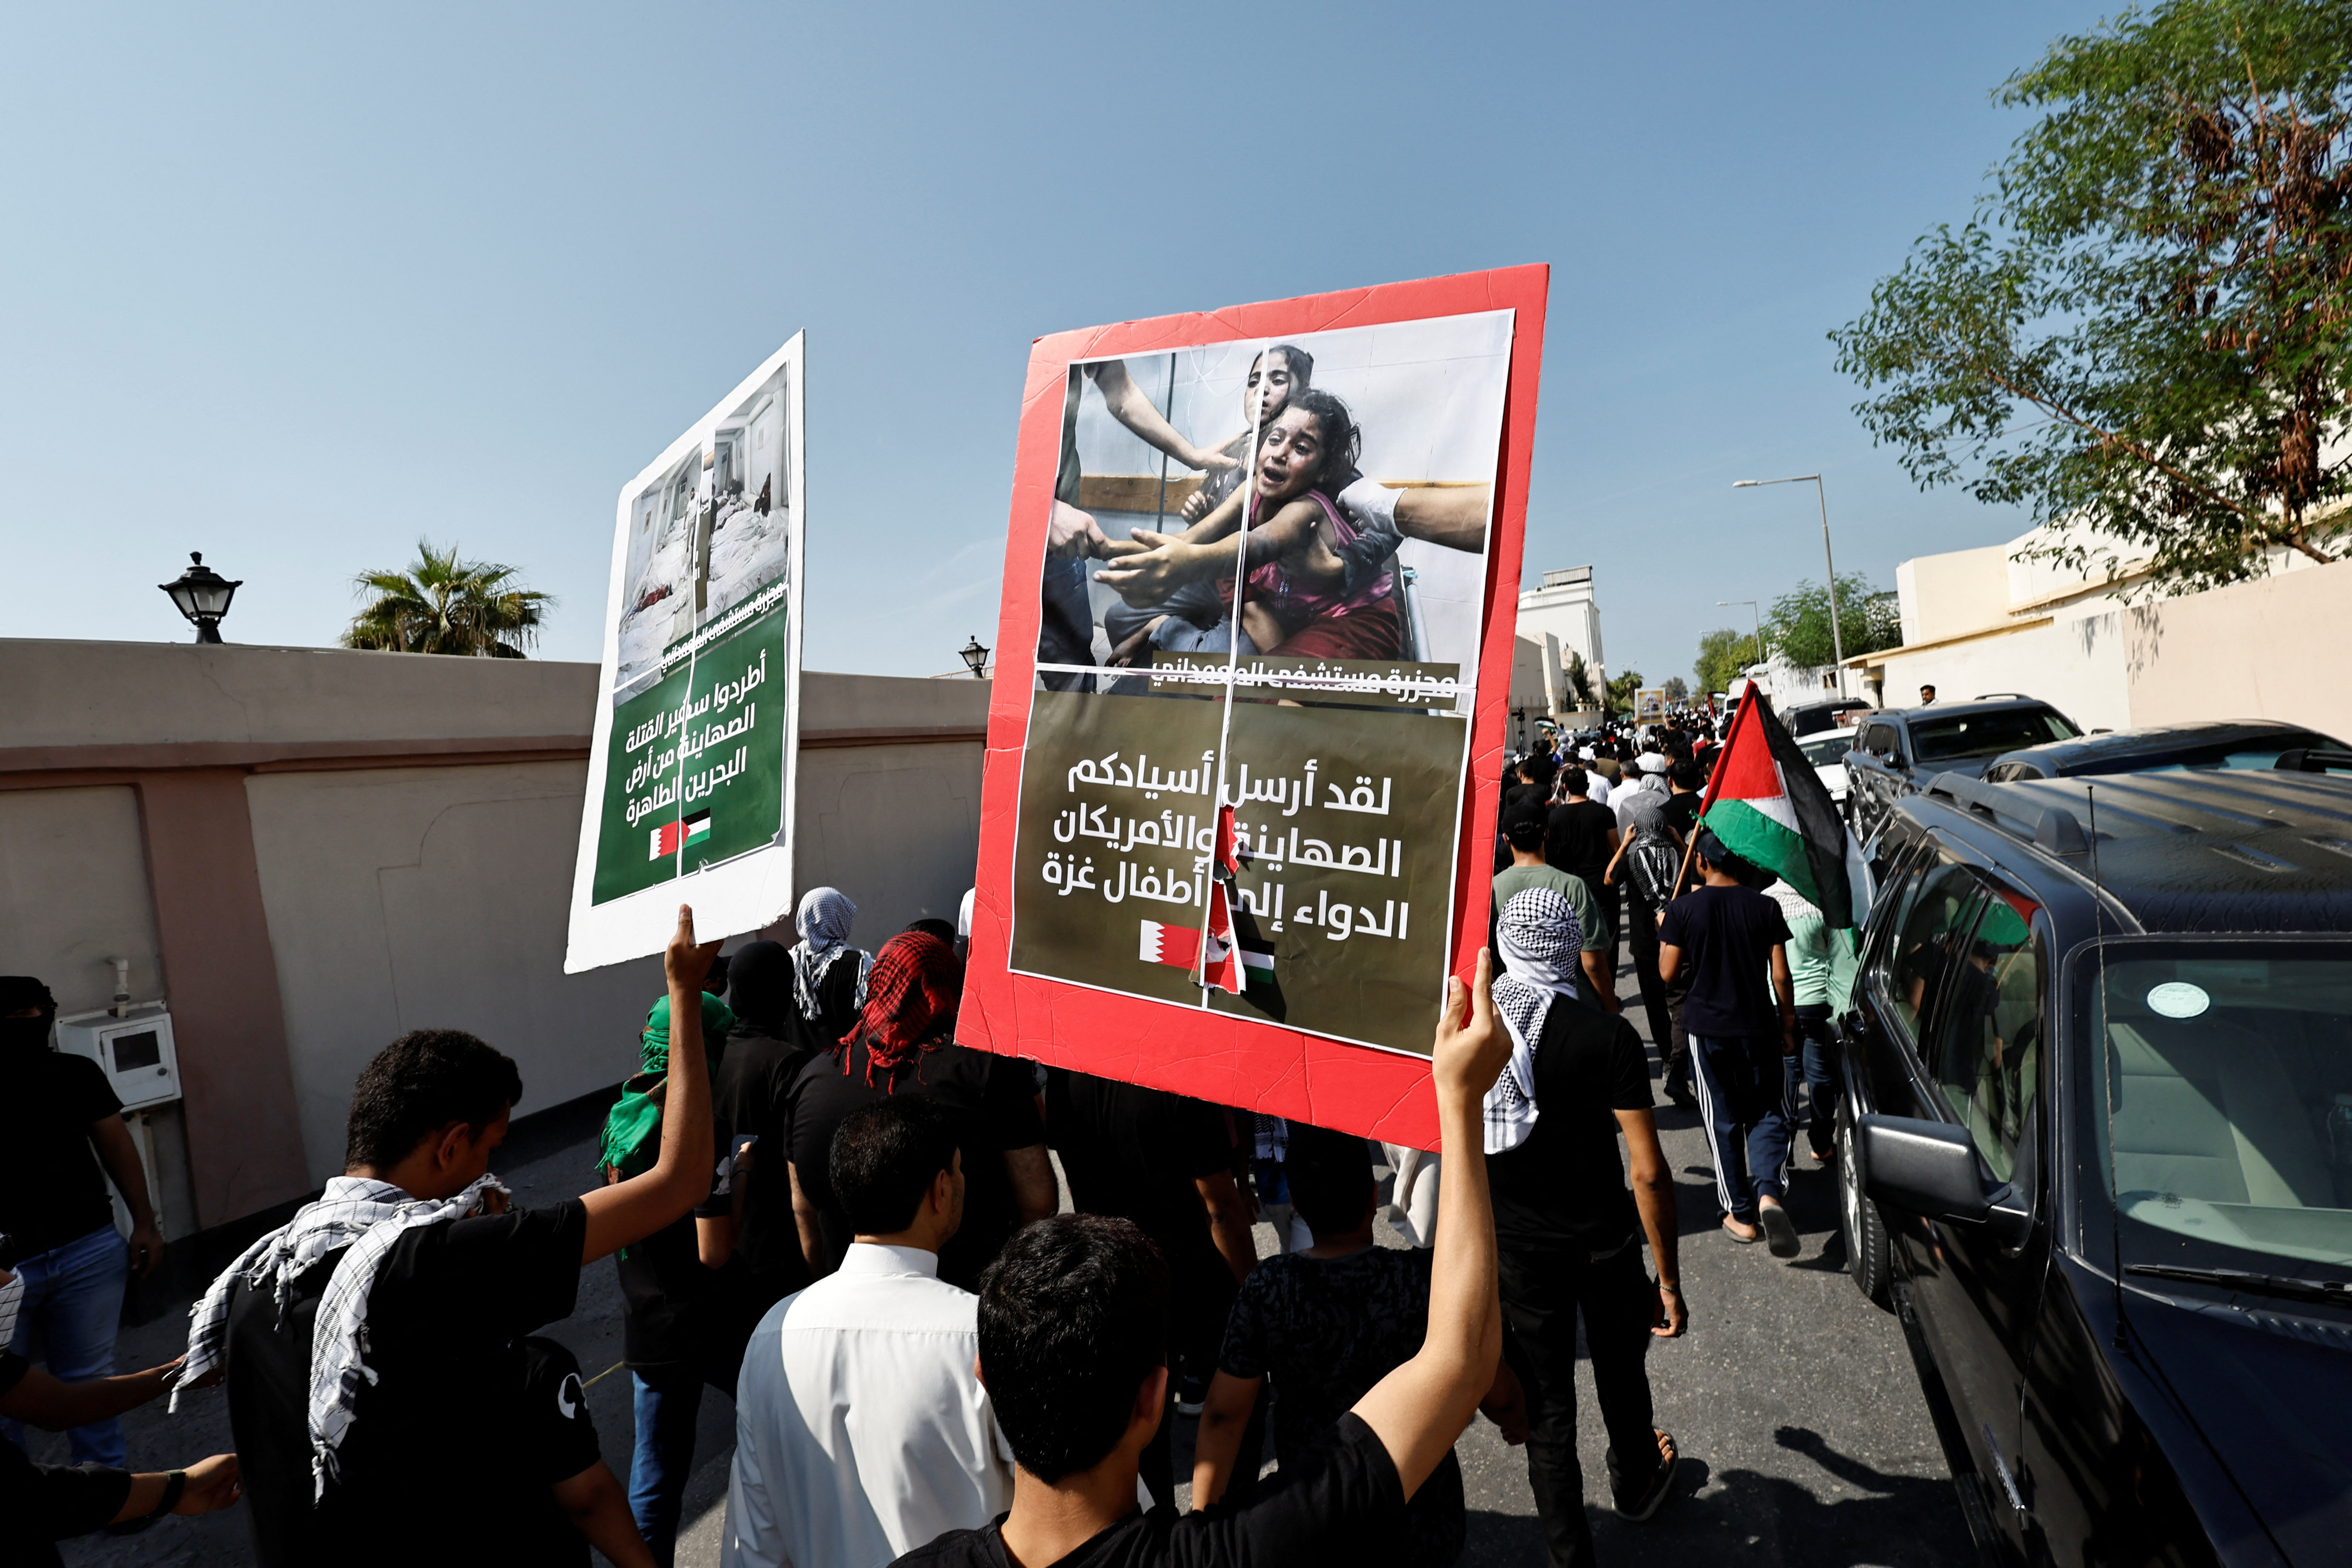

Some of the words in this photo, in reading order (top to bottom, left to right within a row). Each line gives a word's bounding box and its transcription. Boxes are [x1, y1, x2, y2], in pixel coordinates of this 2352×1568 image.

[756, 582, 783, 613] مجزرة
[709, 601, 754, 640] مستشفى
[713, 648, 765, 713] أطردوا
[1151, 658, 1264, 687] المعمداني
[1268, 662, 1380, 693] مستشفى
[1386, 669, 1456, 703] مجزرة
[626, 712, 664, 753] القتلة
[664, 694, 709, 739] سفير
[677, 703, 755, 760] الصهاينة
[626, 745, 653, 793] أرض
[653, 748, 674, 779] من
[685, 746, 747, 802] البحرين
[1068, 750, 1214, 800] أسيادكم
[626, 775, 681, 828] الطاهرة
[1223, 759, 1318, 816] أرسل
[1324, 776, 1391, 815] لقد
[1054, 803, 1214, 863] والأمريكان
[1042, 852, 1095, 895] غزة
[1104, 861, 1204, 907] أطفال
[1294, 890, 1409, 940] الدواء
